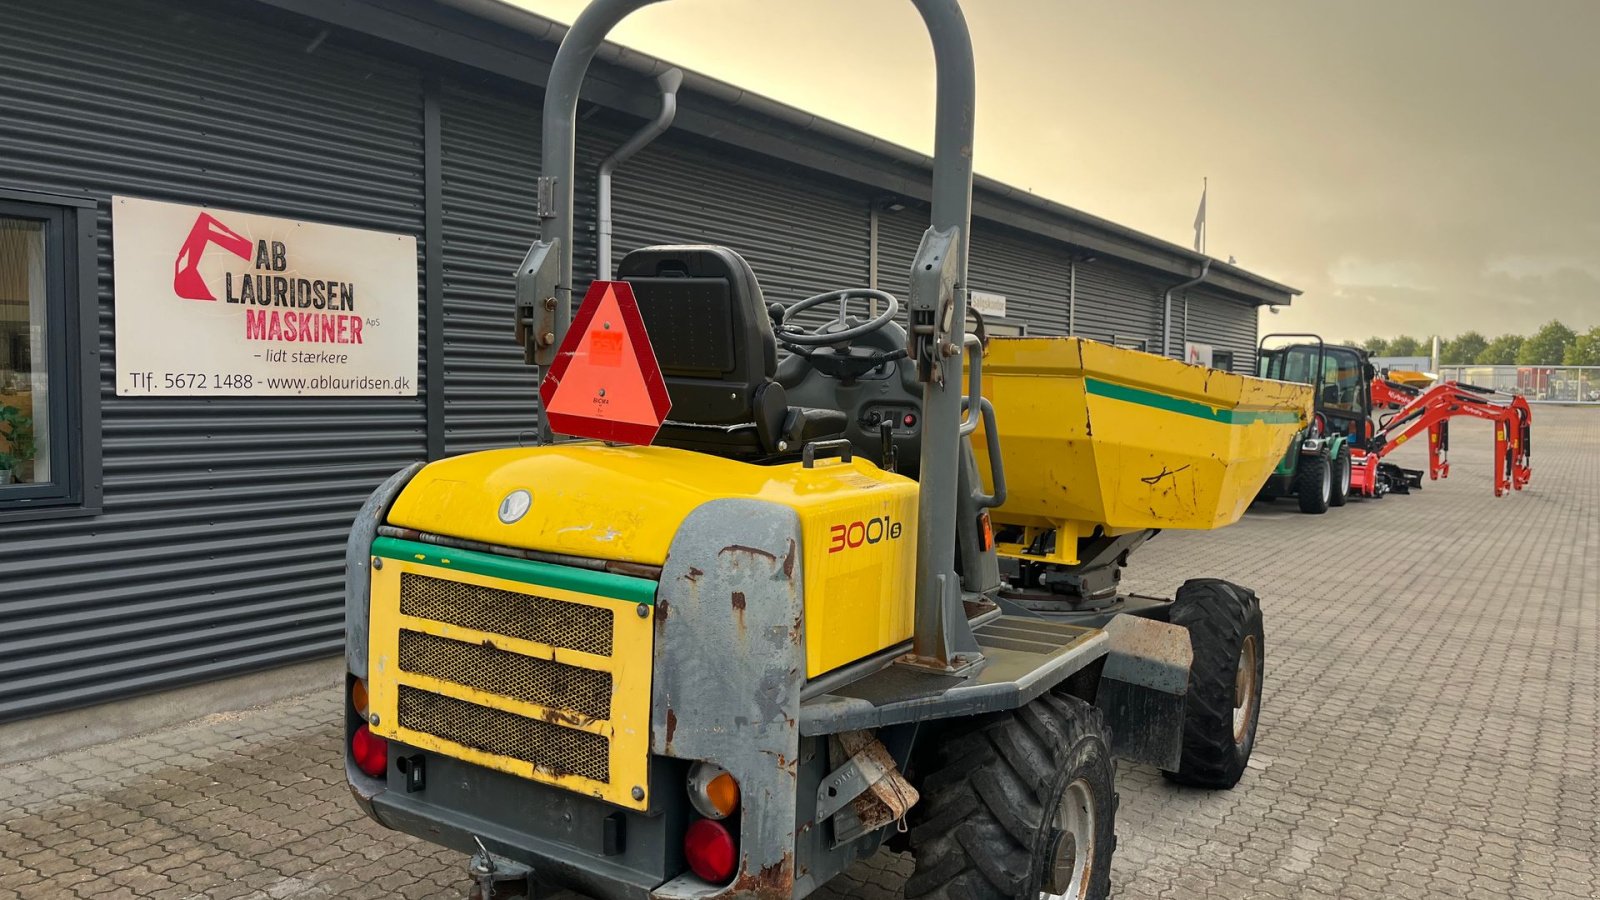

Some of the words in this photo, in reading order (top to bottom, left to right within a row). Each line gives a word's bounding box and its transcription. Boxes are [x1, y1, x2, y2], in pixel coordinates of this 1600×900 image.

[255, 239, 287, 272] AB
[225, 272, 354, 312] LAURIDSEN
[246, 309, 364, 344] MASKINER
[365, 317, 381, 327] ApS
[265, 348, 287, 364] lidt
[291, 349, 348, 365] stærkere
[129, 371, 158, 392] Tlf.
[164, 373, 207, 390] 5672
[213, 373, 253, 390] 1488
[267, 375, 410, 391] www.ablauridsen.dk
